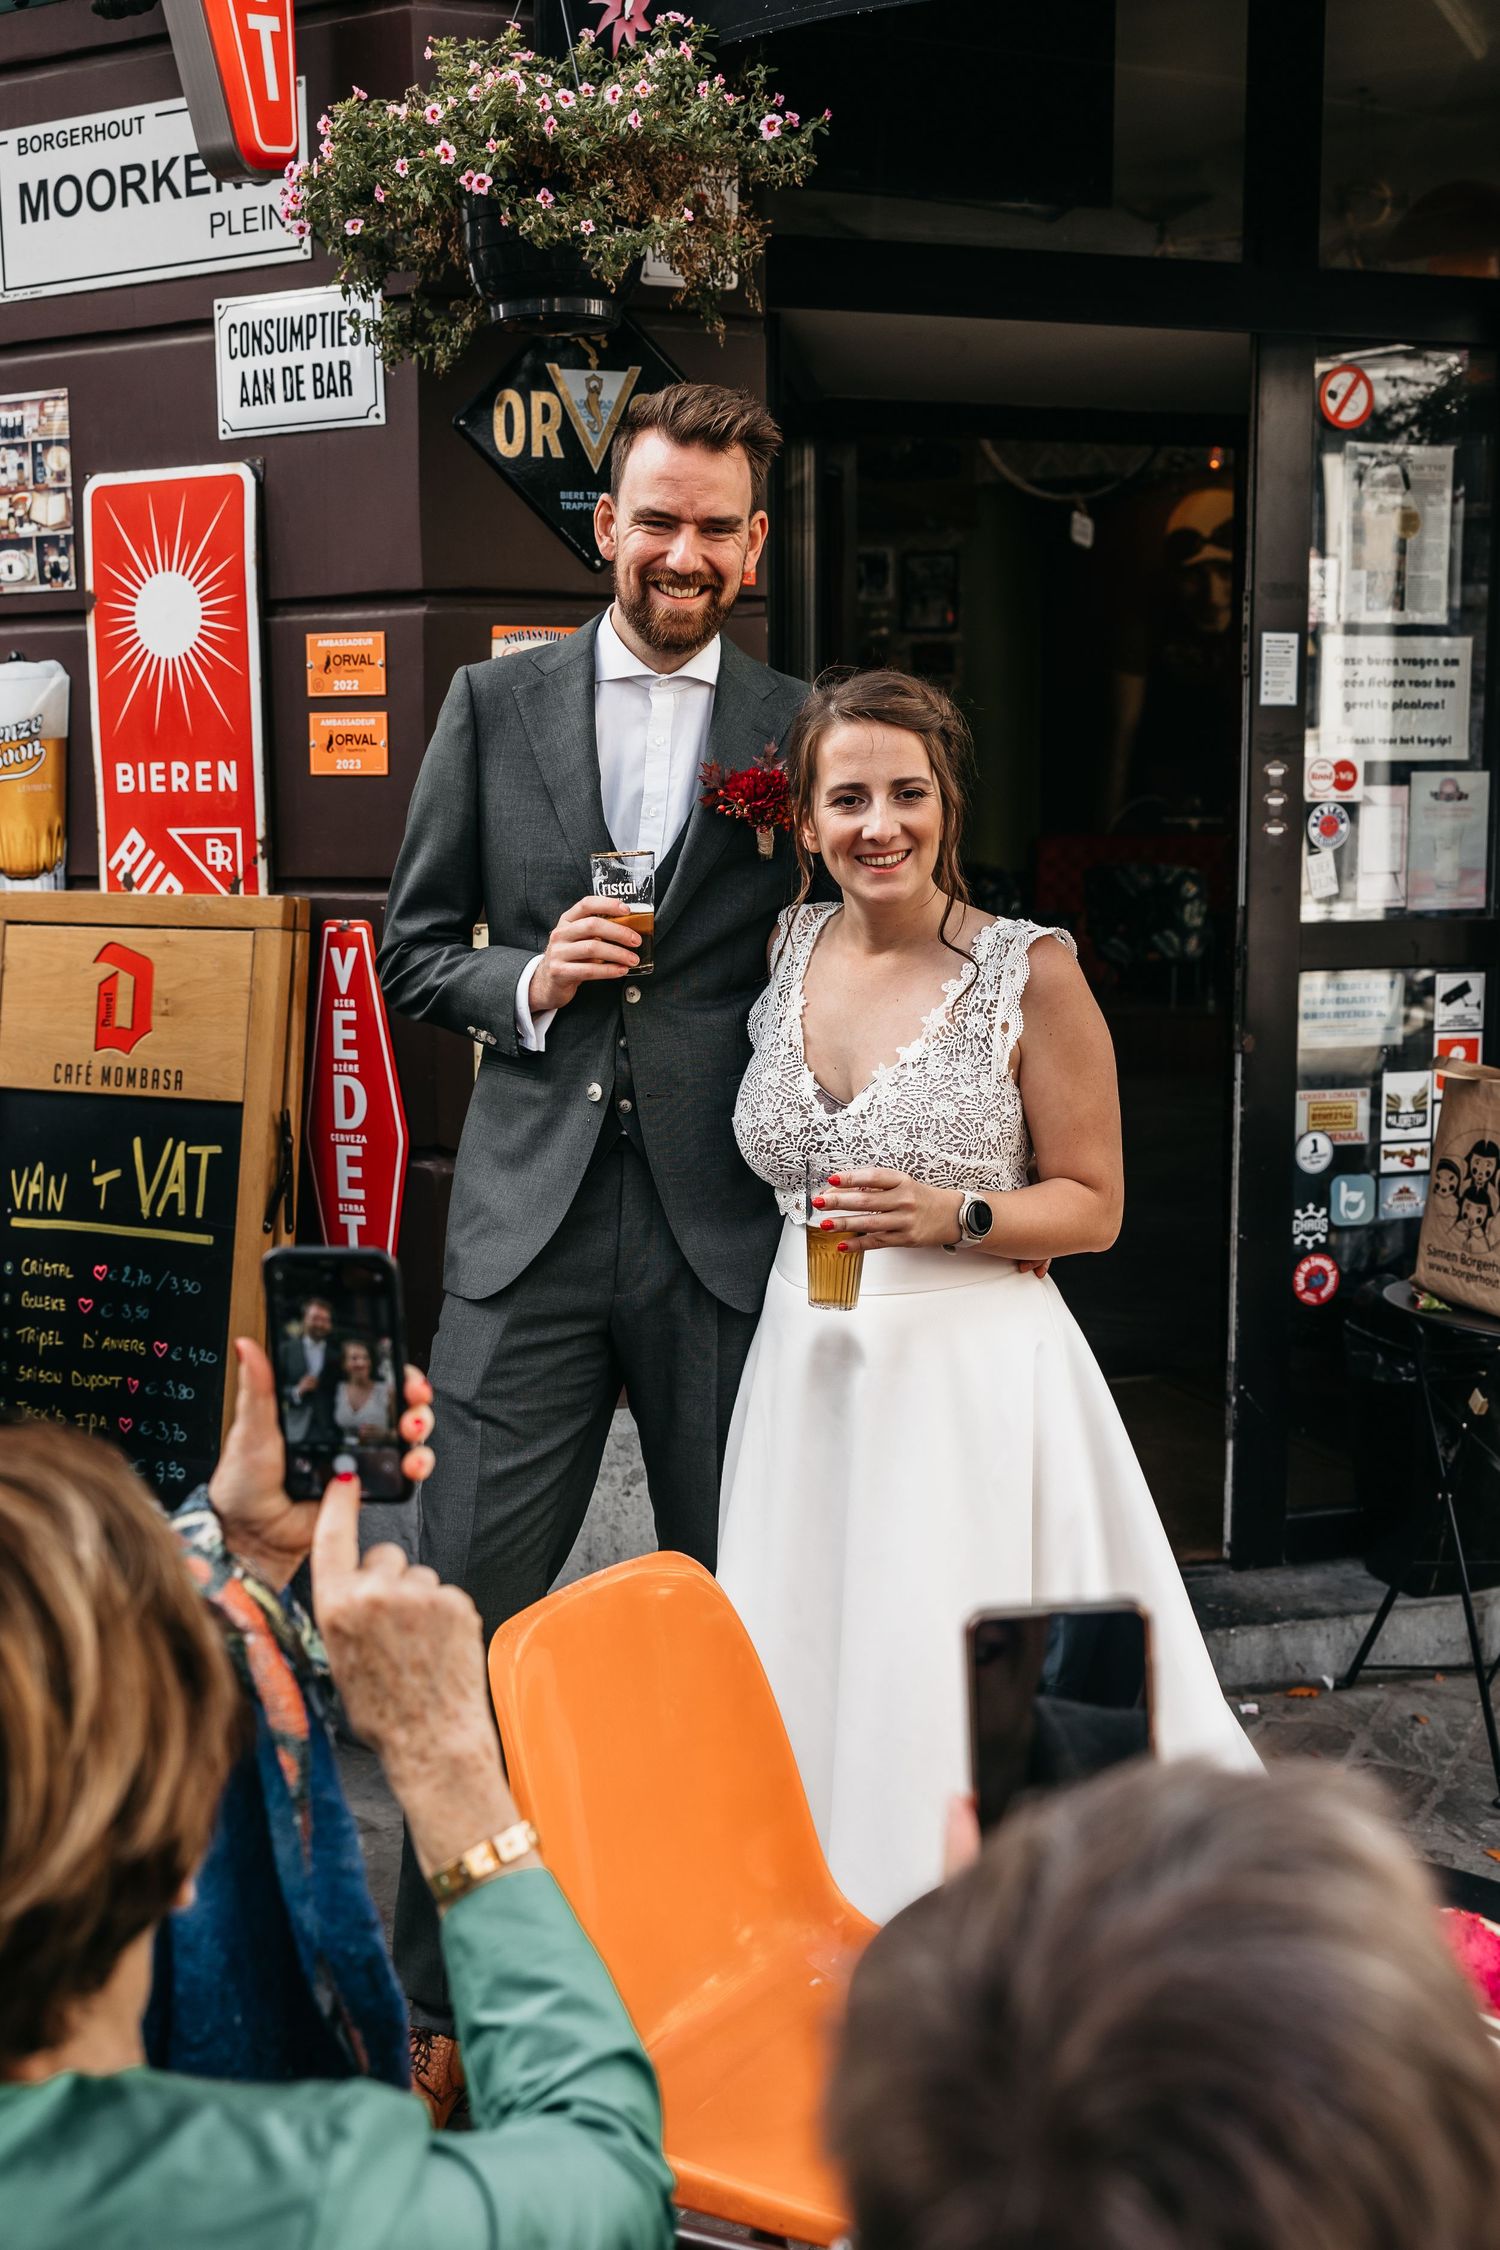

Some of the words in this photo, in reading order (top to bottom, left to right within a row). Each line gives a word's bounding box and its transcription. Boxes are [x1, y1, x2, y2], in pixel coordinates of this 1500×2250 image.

[246, 0, 281, 102] T
[17, 115, 146, 156] BORGERHOUT
[18, 152, 272, 225] MOORKE
[209, 203, 286, 239] PLEIN
[228, 308, 361, 360] CONSUMPTIES
[240, 368, 276, 408] AAN
[282, 365, 306, 403] DE
[312, 360, 353, 400] BAR
[493, 363, 650, 475] ORV
[317, 638, 373, 648] AMBASSADEUR
[332, 654, 375, 667] ORVAL
[333, 680, 359, 691] 2022
[320, 718, 376, 727] AMBASSADEUR
[335, 734, 377, 746] ORVAL
[336, 759, 361, 770] 2023
[115, 760, 238, 793] BIEREN
[334, 998, 355, 1008] BIER
[53, 1060, 93, 1086] CAFÉ
[101, 1065, 183, 1091] MOMBASA
[330, 1132, 367, 1144] CERVEZA
[11, 1161, 67, 1212] VAN
[133, 1136, 223, 1219] VAT
[338, 1203, 365, 1213] BIRRA
[121, 1266, 152, 1288] 2,70
[121, 1304, 150, 1323] 3,50
